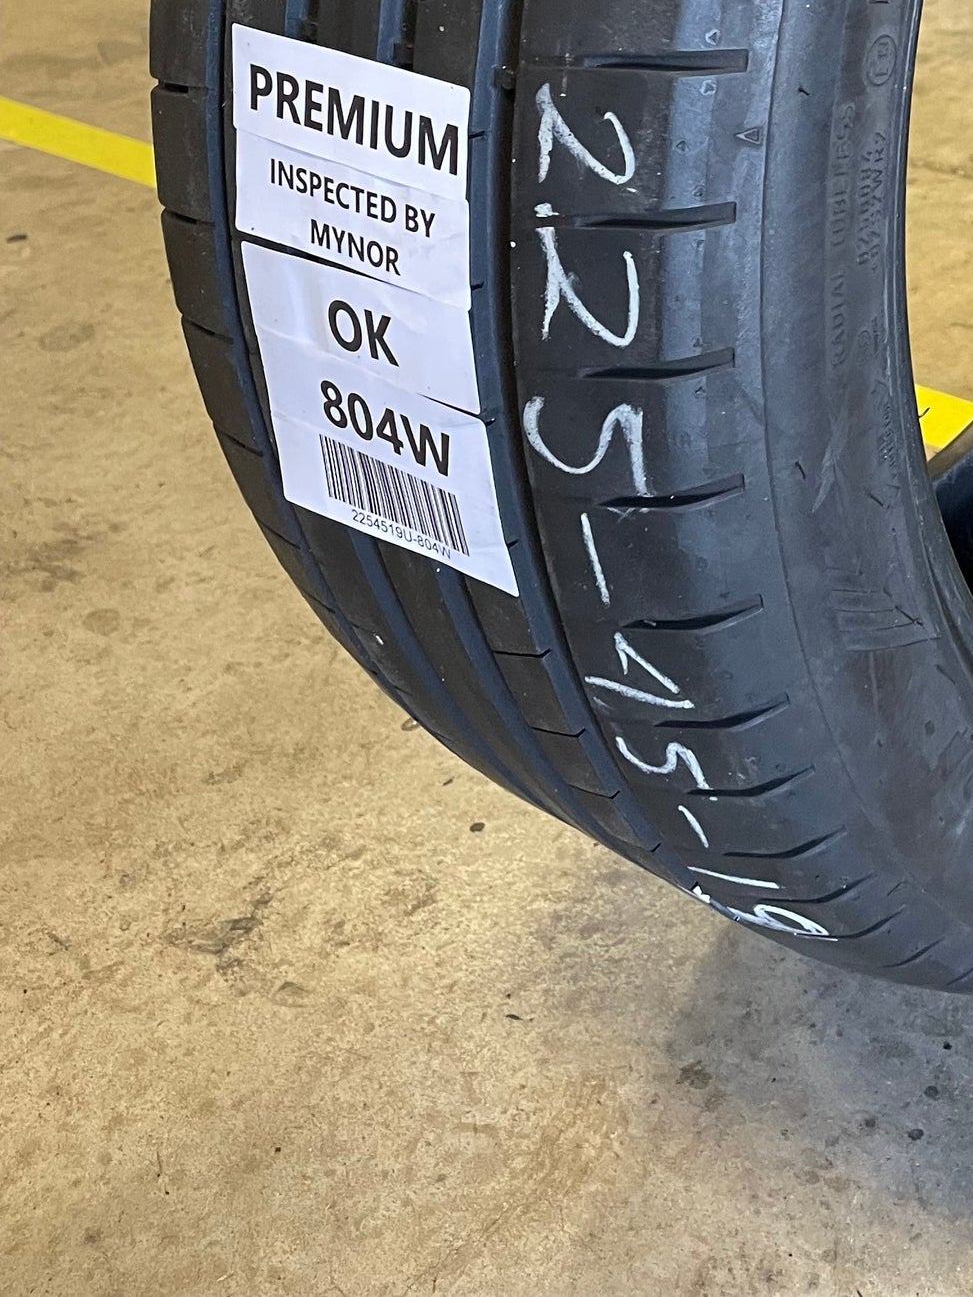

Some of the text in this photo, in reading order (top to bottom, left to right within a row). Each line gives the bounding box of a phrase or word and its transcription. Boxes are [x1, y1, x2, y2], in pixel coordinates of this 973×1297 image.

[250, 63, 458, 175] PREMIUM
[270, 158, 436, 238] INSPECTED BY
[310, 219, 400, 276] MYNOR
[327, 300, 399, 367] OK
[320, 380, 451, 476] 804W
[351, 509, 452, 559] 2254519U-804W
